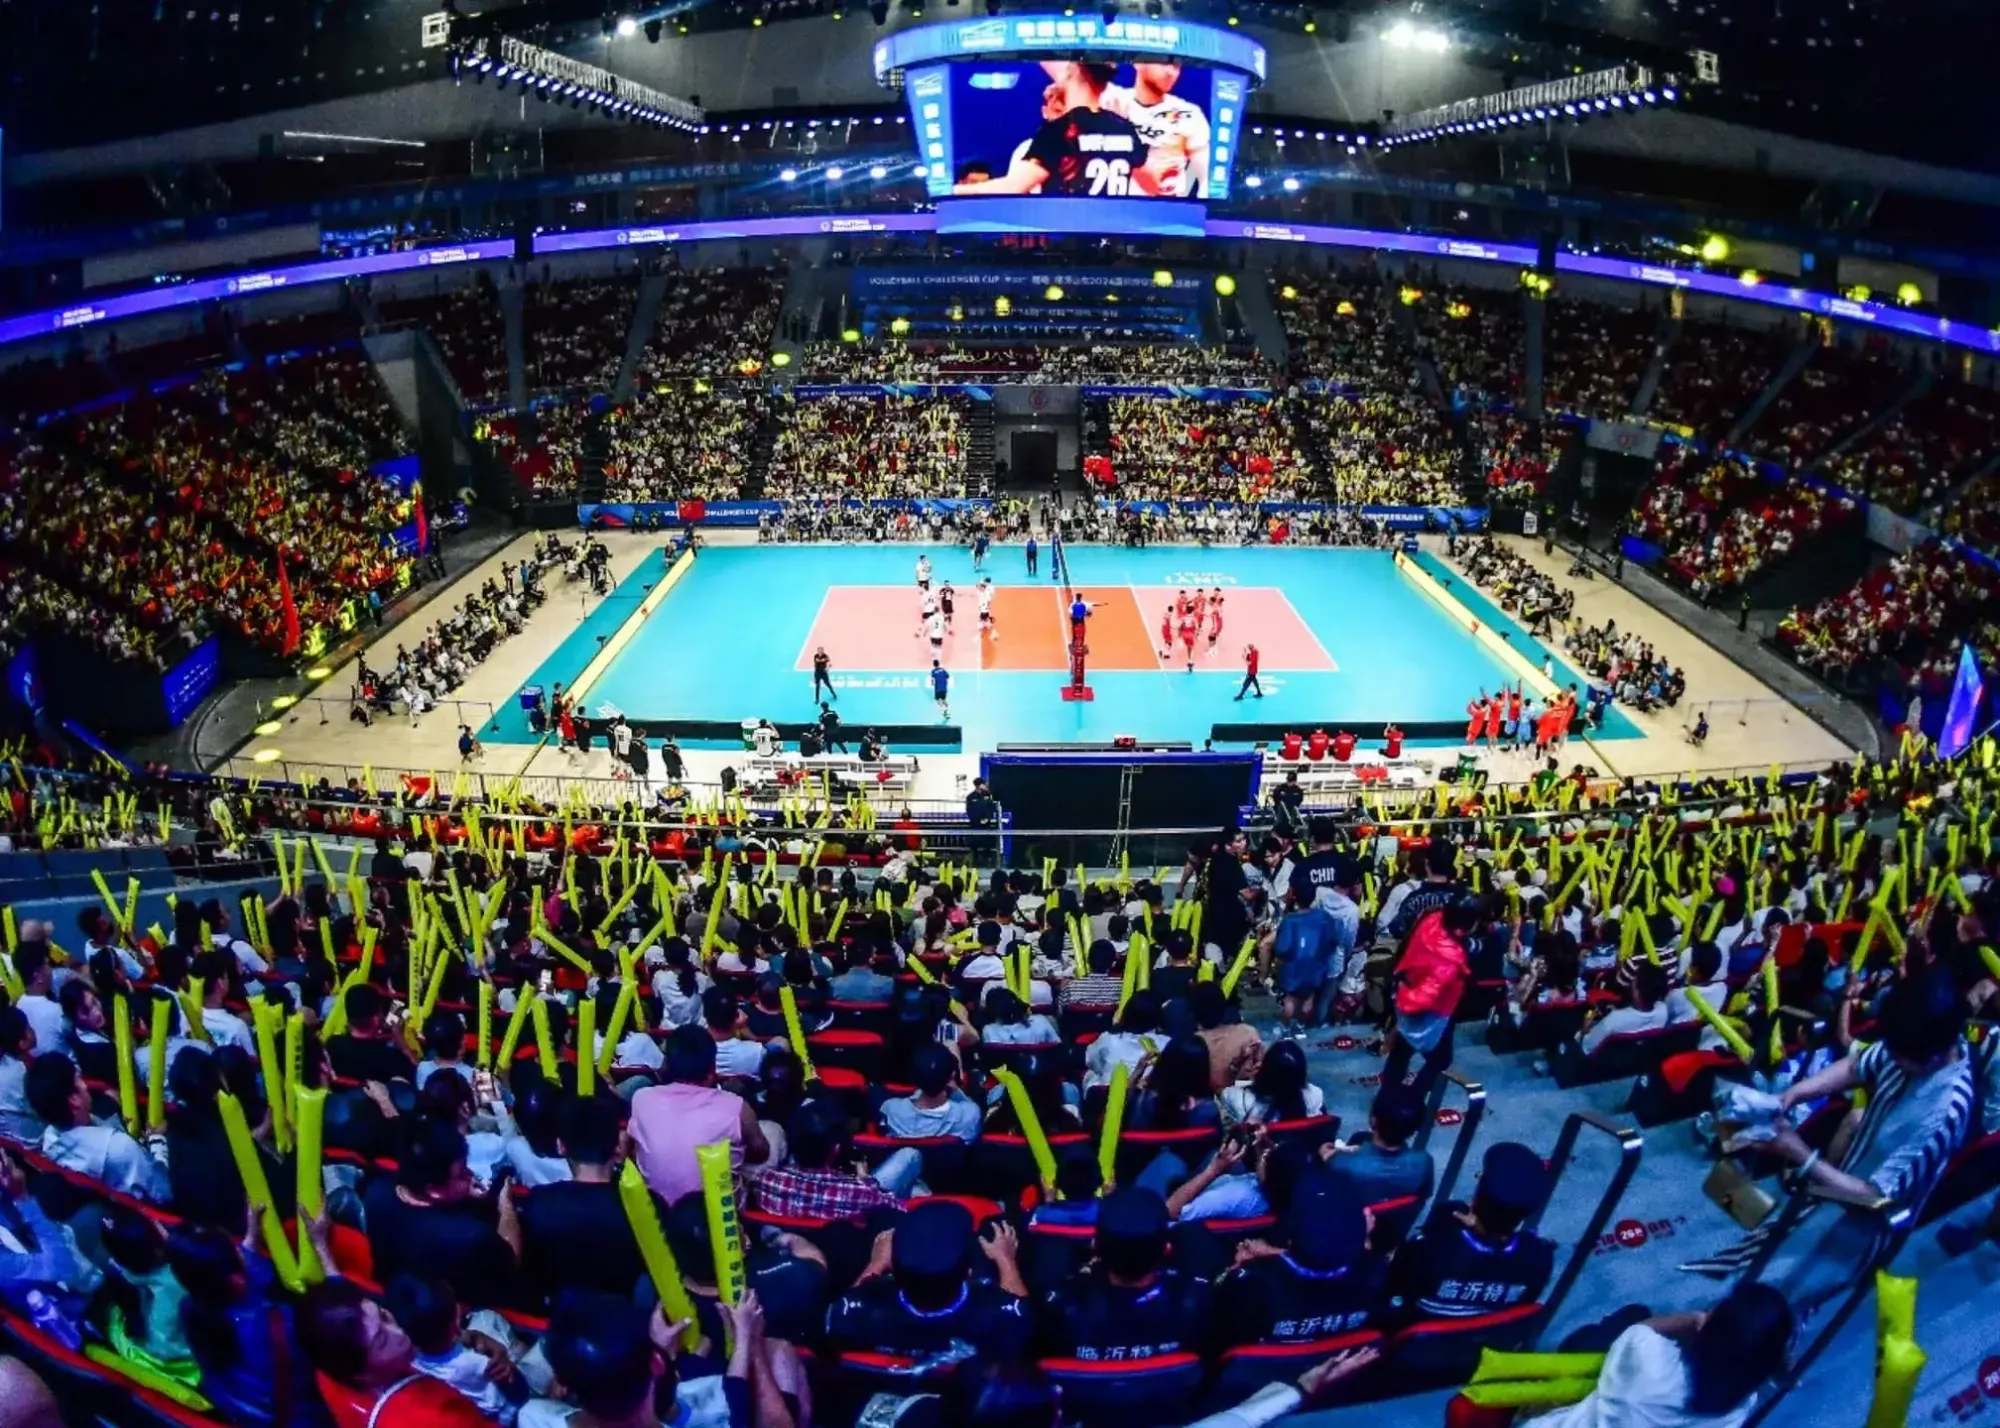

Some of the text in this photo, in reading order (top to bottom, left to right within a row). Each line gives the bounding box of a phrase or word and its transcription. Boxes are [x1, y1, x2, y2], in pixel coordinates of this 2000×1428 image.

[1085, 158, 1130, 196] 26
[923, 275, 980, 284] CHALLENGER
[982, 275, 1000, 284] CUP
